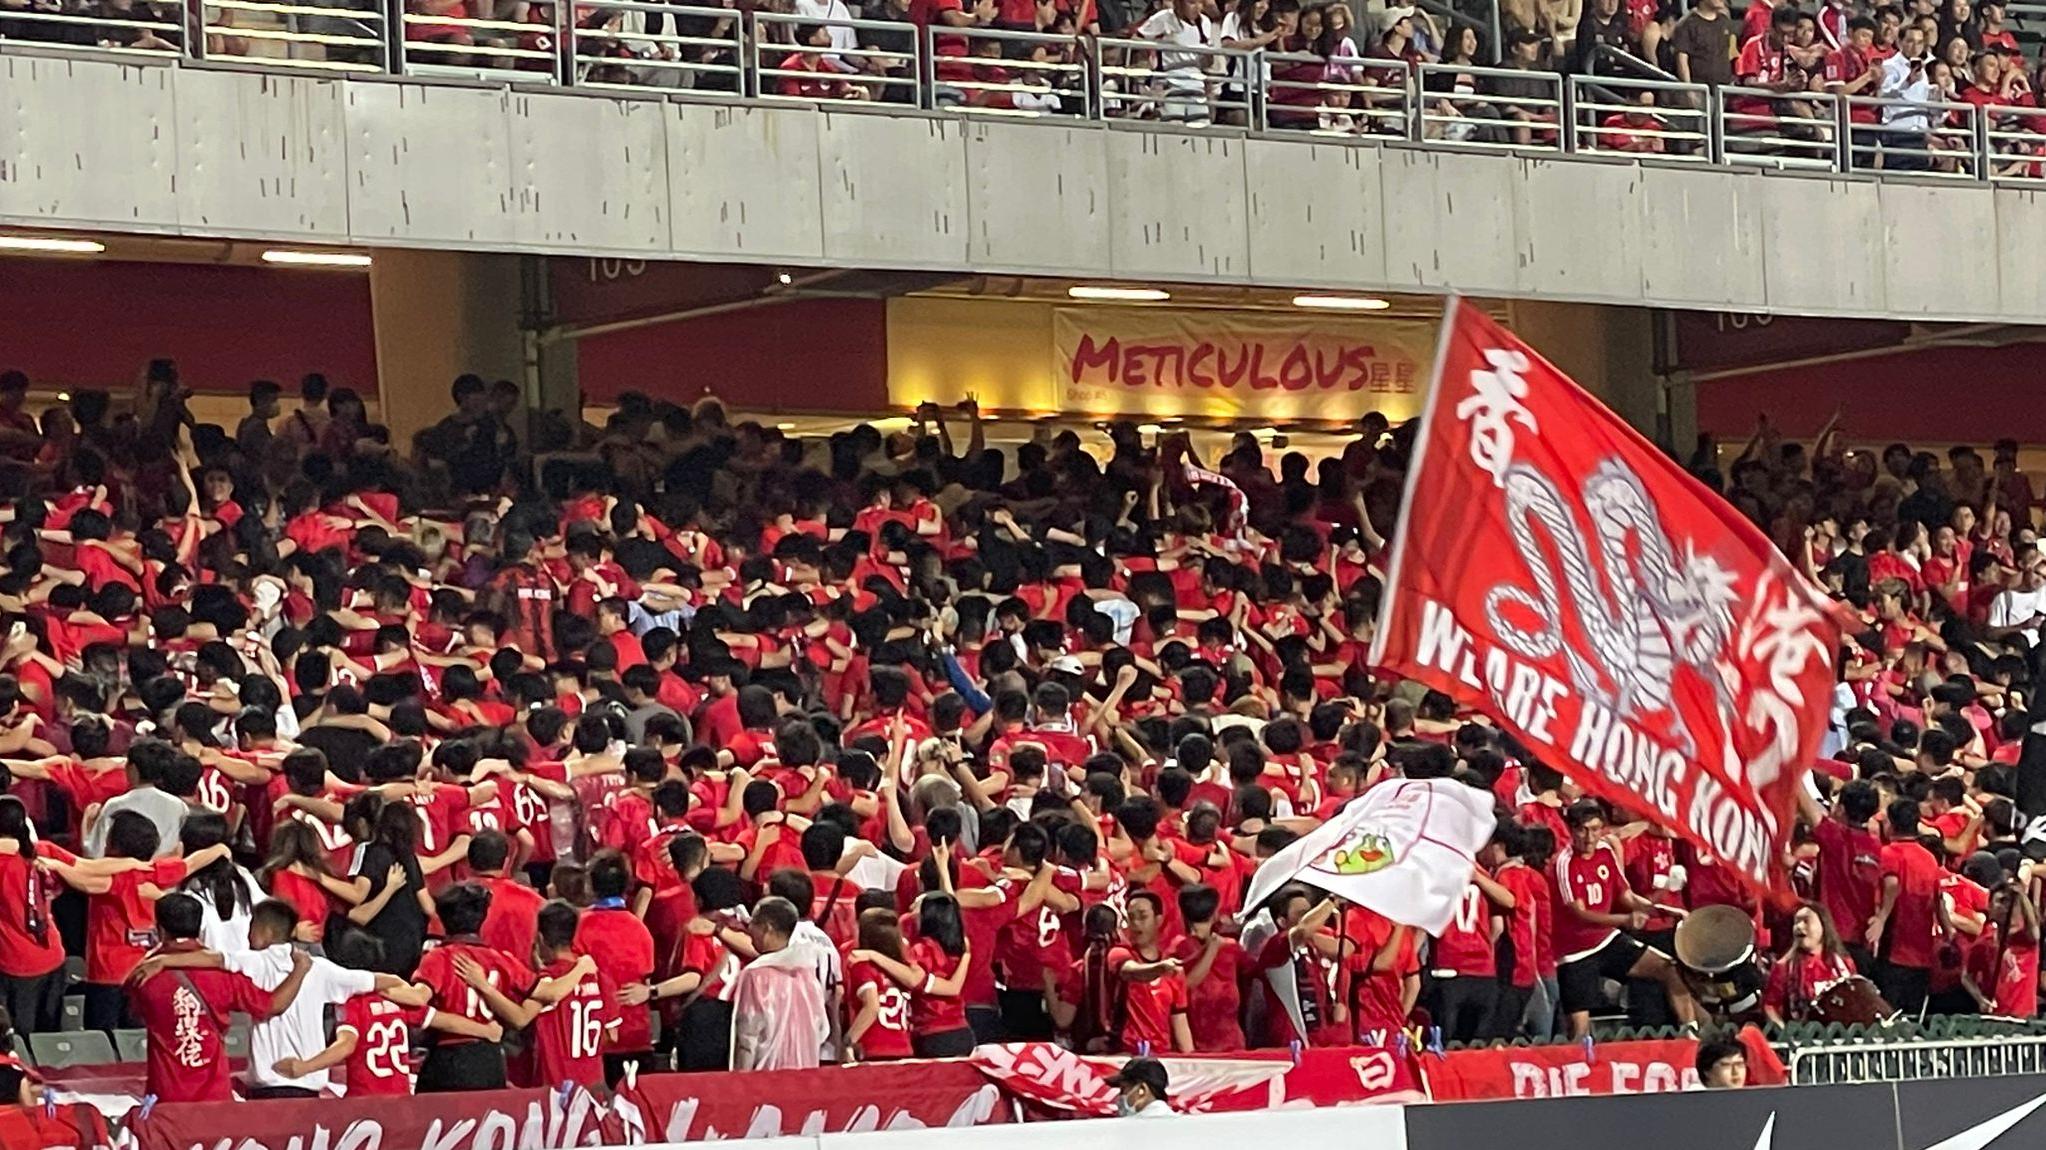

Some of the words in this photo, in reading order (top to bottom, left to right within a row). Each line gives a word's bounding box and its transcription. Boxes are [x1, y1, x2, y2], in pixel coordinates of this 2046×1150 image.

[1072, 333, 1375, 391] METICULOUS
[1371, 362, 1415, 393] 星星
[1456, 348, 1539, 489] 香
[1485, 644, 1569, 745] ARE
[1570, 700, 1686, 821] HONG
[1688, 771, 1774, 882] KON
[1586, 882, 1602, 905] 10
[366, 1018, 410, 1078] 22
[570, 1000, 604, 1059] 16
